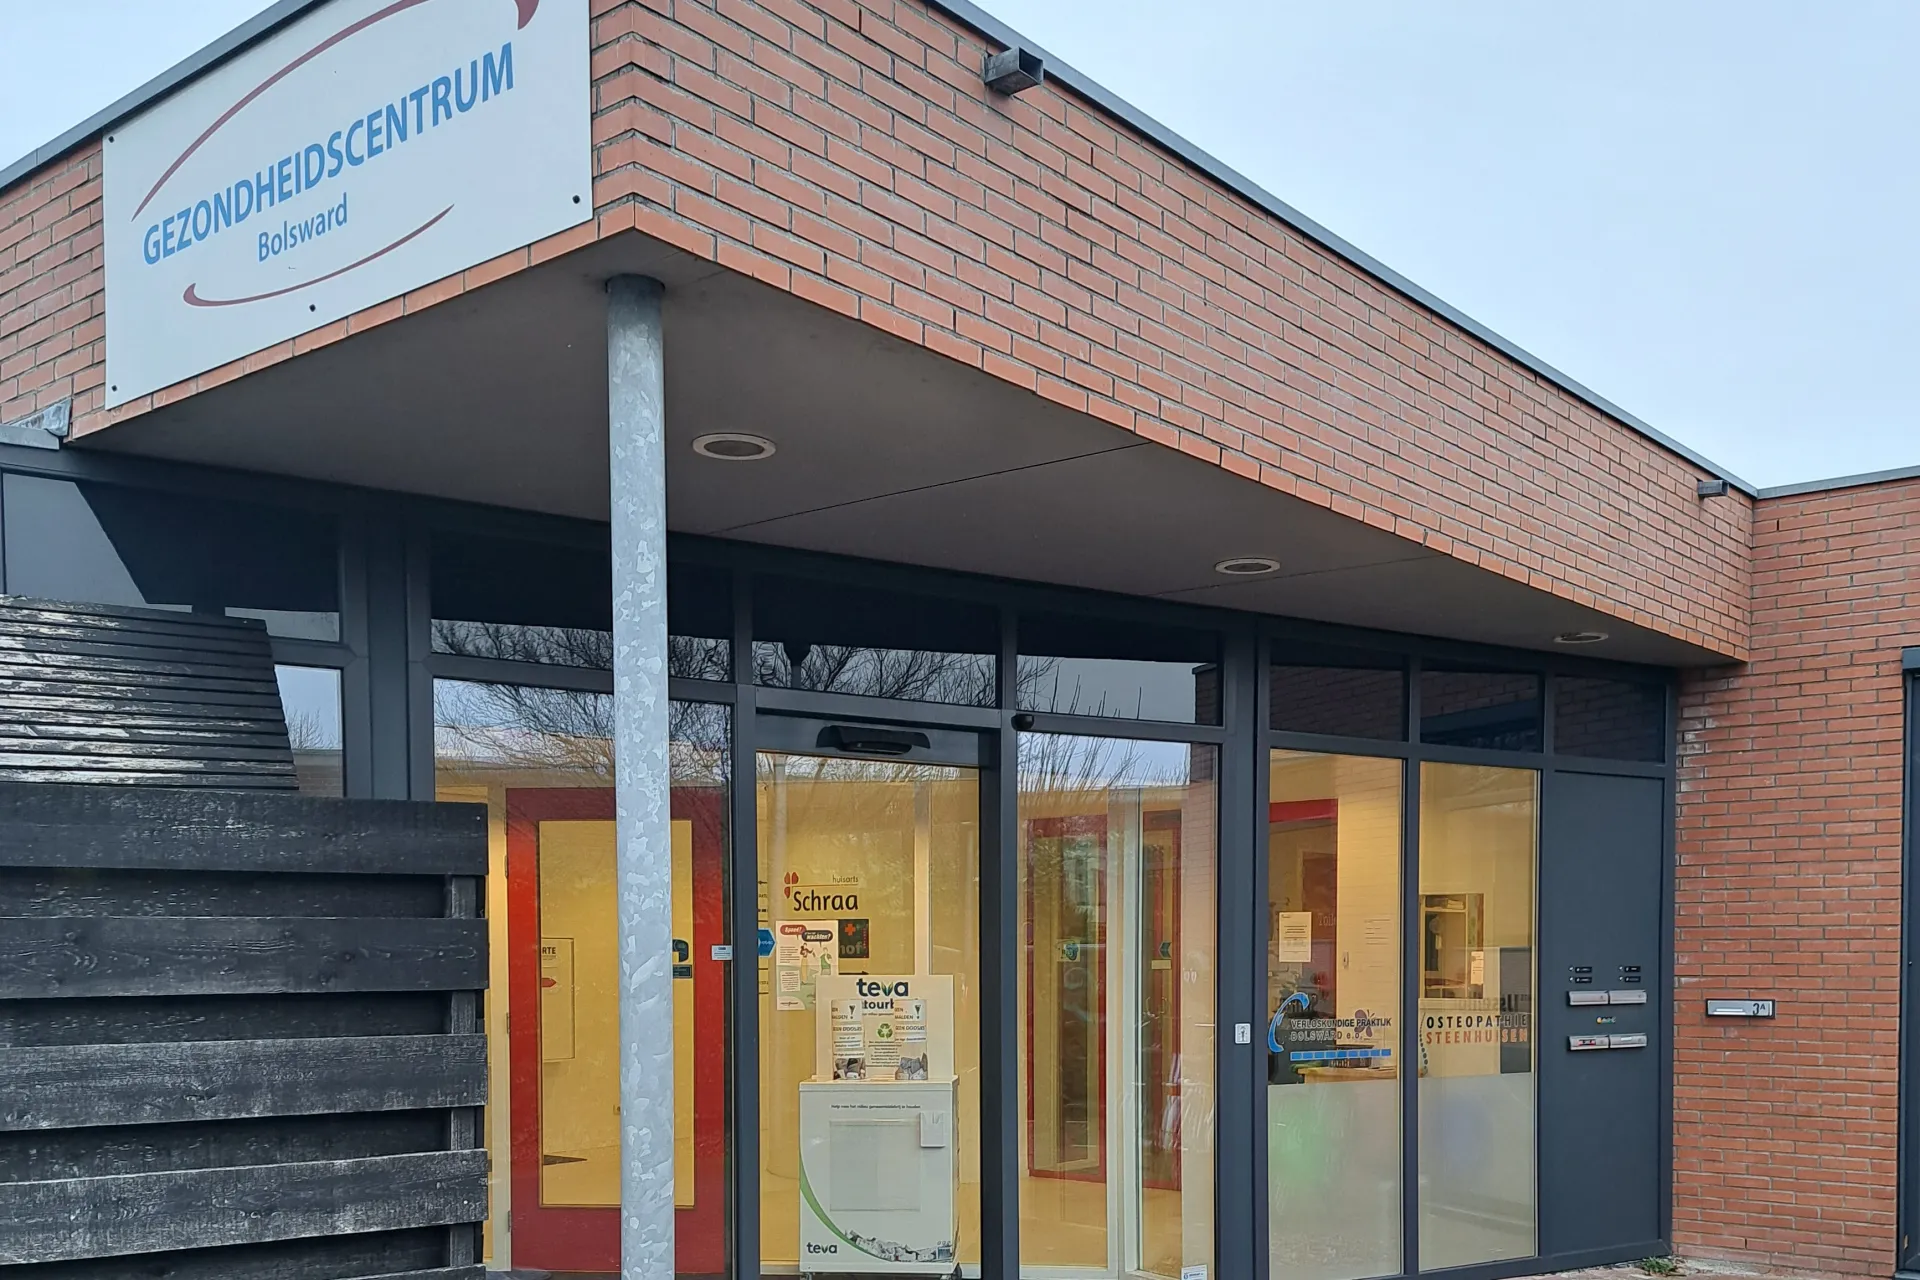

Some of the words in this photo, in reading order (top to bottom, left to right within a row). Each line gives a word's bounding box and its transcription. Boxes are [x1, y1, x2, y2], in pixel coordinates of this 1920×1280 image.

[142, 42, 515, 266] GEZONDHEIDSCENTRUM
[257, 193, 349, 262] Bolsward
[832, 874, 859, 883] huisarts
[793, 889, 859, 911] Schraa
[856, 978, 909, 997] teva
[1290, 1018, 1355, 1030] VERLOSKUNDIGE
[1356, 1017, 1392, 1028] PRAKTIJK
[1426, 1013, 1528, 1029] OSTEOPATHIE
[1290, 1030, 1343, 1042] BOLSWARD
[1426, 1028, 1528, 1045] STEENHUISEN
[806, 1242, 838, 1254] teva
